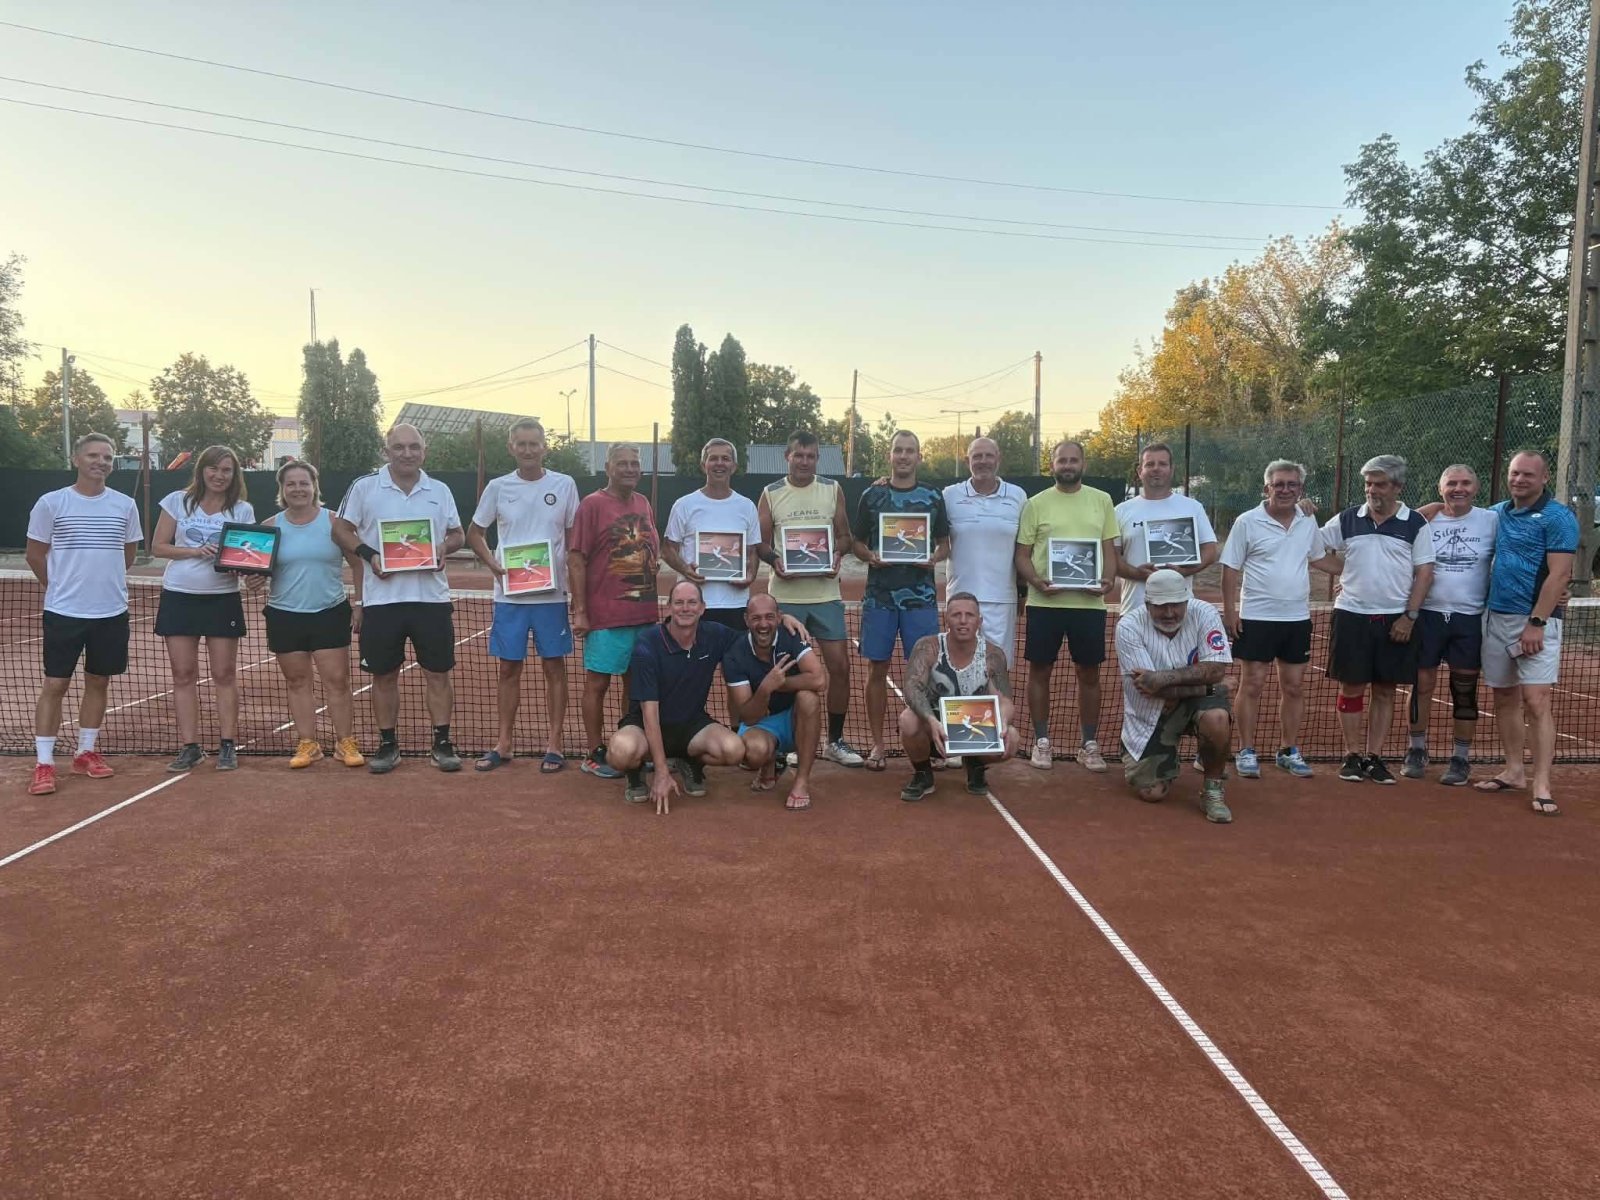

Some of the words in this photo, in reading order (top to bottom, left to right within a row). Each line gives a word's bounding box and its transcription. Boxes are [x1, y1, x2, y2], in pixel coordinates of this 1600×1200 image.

[787, 509, 820, 518] JEANS
[1432, 527, 1468, 542] Silent
[1449, 535, 1481, 545] Ocean
